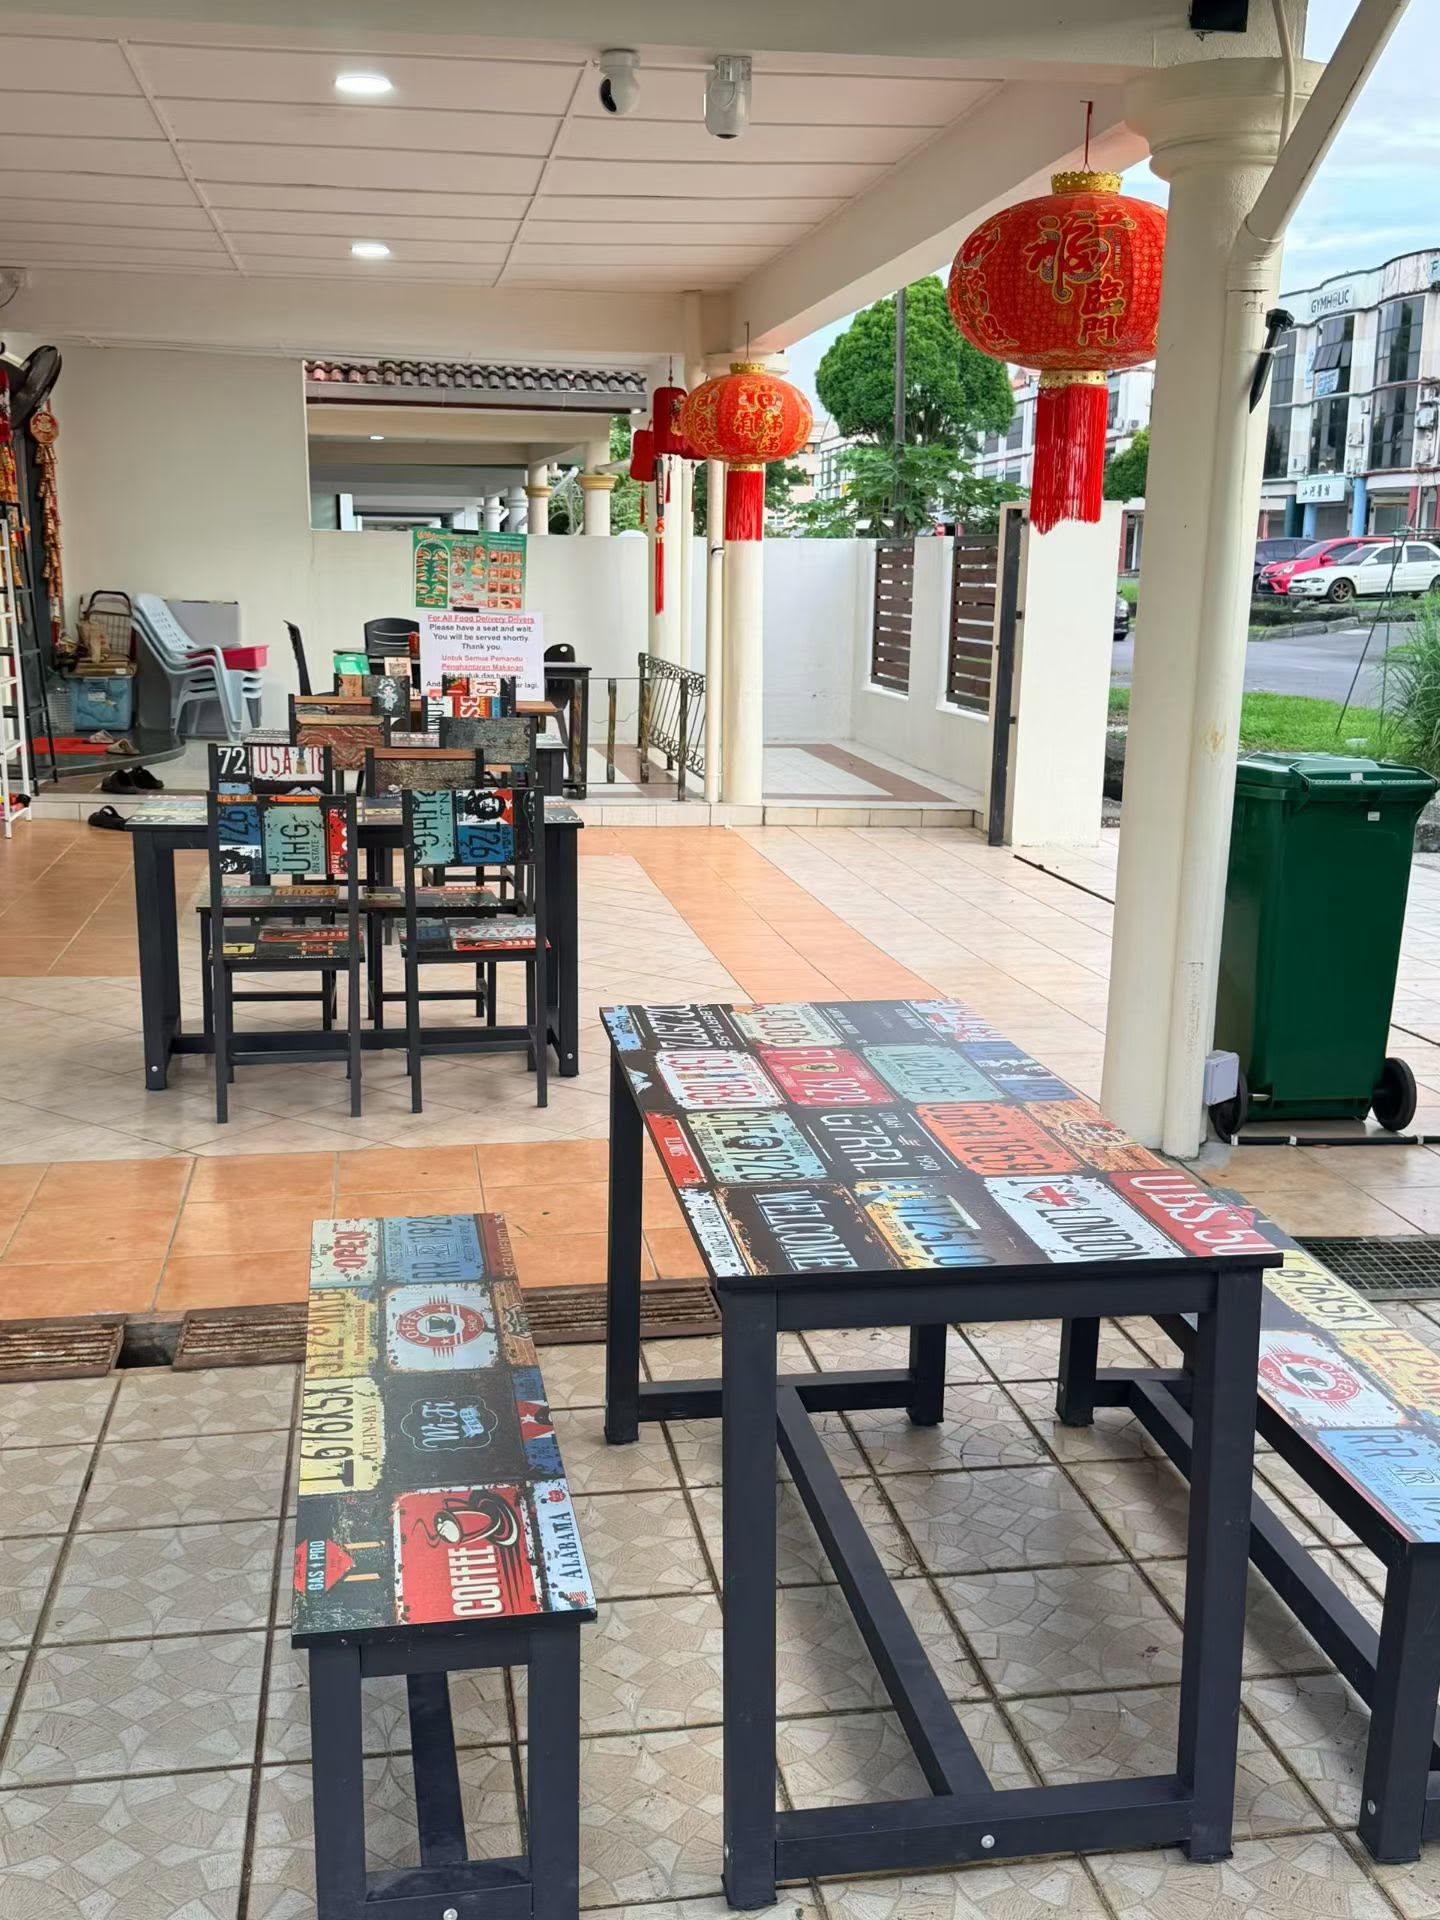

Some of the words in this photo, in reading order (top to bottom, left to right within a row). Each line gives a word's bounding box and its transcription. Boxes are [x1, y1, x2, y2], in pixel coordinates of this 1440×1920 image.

[427, 614, 441, 623] For
[442, 615, 453, 623] All
[454, 615, 473, 623] Food
[475, 615, 506, 625] Delivery
[508, 616, 535, 625] Drivers
[429, 623, 454, 632] Please
[456, 623, 474, 632] have
[500, 624, 517, 633] and
[519, 625, 534, 633] wait.
[433, 632, 448, 641] You
[450, 632, 463, 641] will
[464, 632, 474, 641] be
[475, 633, 501, 642] served
[462, 642, 485, 651] Thank
[441, 654, 463, 662] Untuk
[492, 664, 524, 672] Makanan
[217, 747, 248, 774] 72
[257, 746, 293, 775] USA
[663, 1051, 738, 1071] USA
[774, 1049, 836, 1061] F1
[797, 1078, 874, 1103] 1929
[706, 1110, 779, 1135] CHE
[876, 1112, 904, 1128] UTAH
[923, 1104, 1011, 1128] GBR
[817, 1112, 910, 1173] G7RRL
[957, 1137, 1055, 1172] 1859
[725, 1149, 808, 1181] 1928
[1007, 1178, 1074, 1187] I
[751, 1189, 859, 1271] WELCOME
[332, 1230, 370, 1268] OPEN
[410, 1260, 461, 1279] RR
[400, 1306, 432, 1344] COFFEE
[465, 1314, 480, 1332] SHOP
[1262, 1366, 1290, 1389] SHOP
[1305, 1357, 1357, 1403] COFFEE
[419, 1398, 461, 1448] Wi-Fi
[462, 1408, 480, 1432] FREE
[307, 1538, 326, 1561] PRO
[550, 1511, 584, 1580] ALABAMA
[305, 1567, 326, 1592] GAS
[447, 1543, 505, 1617] COFFEE
